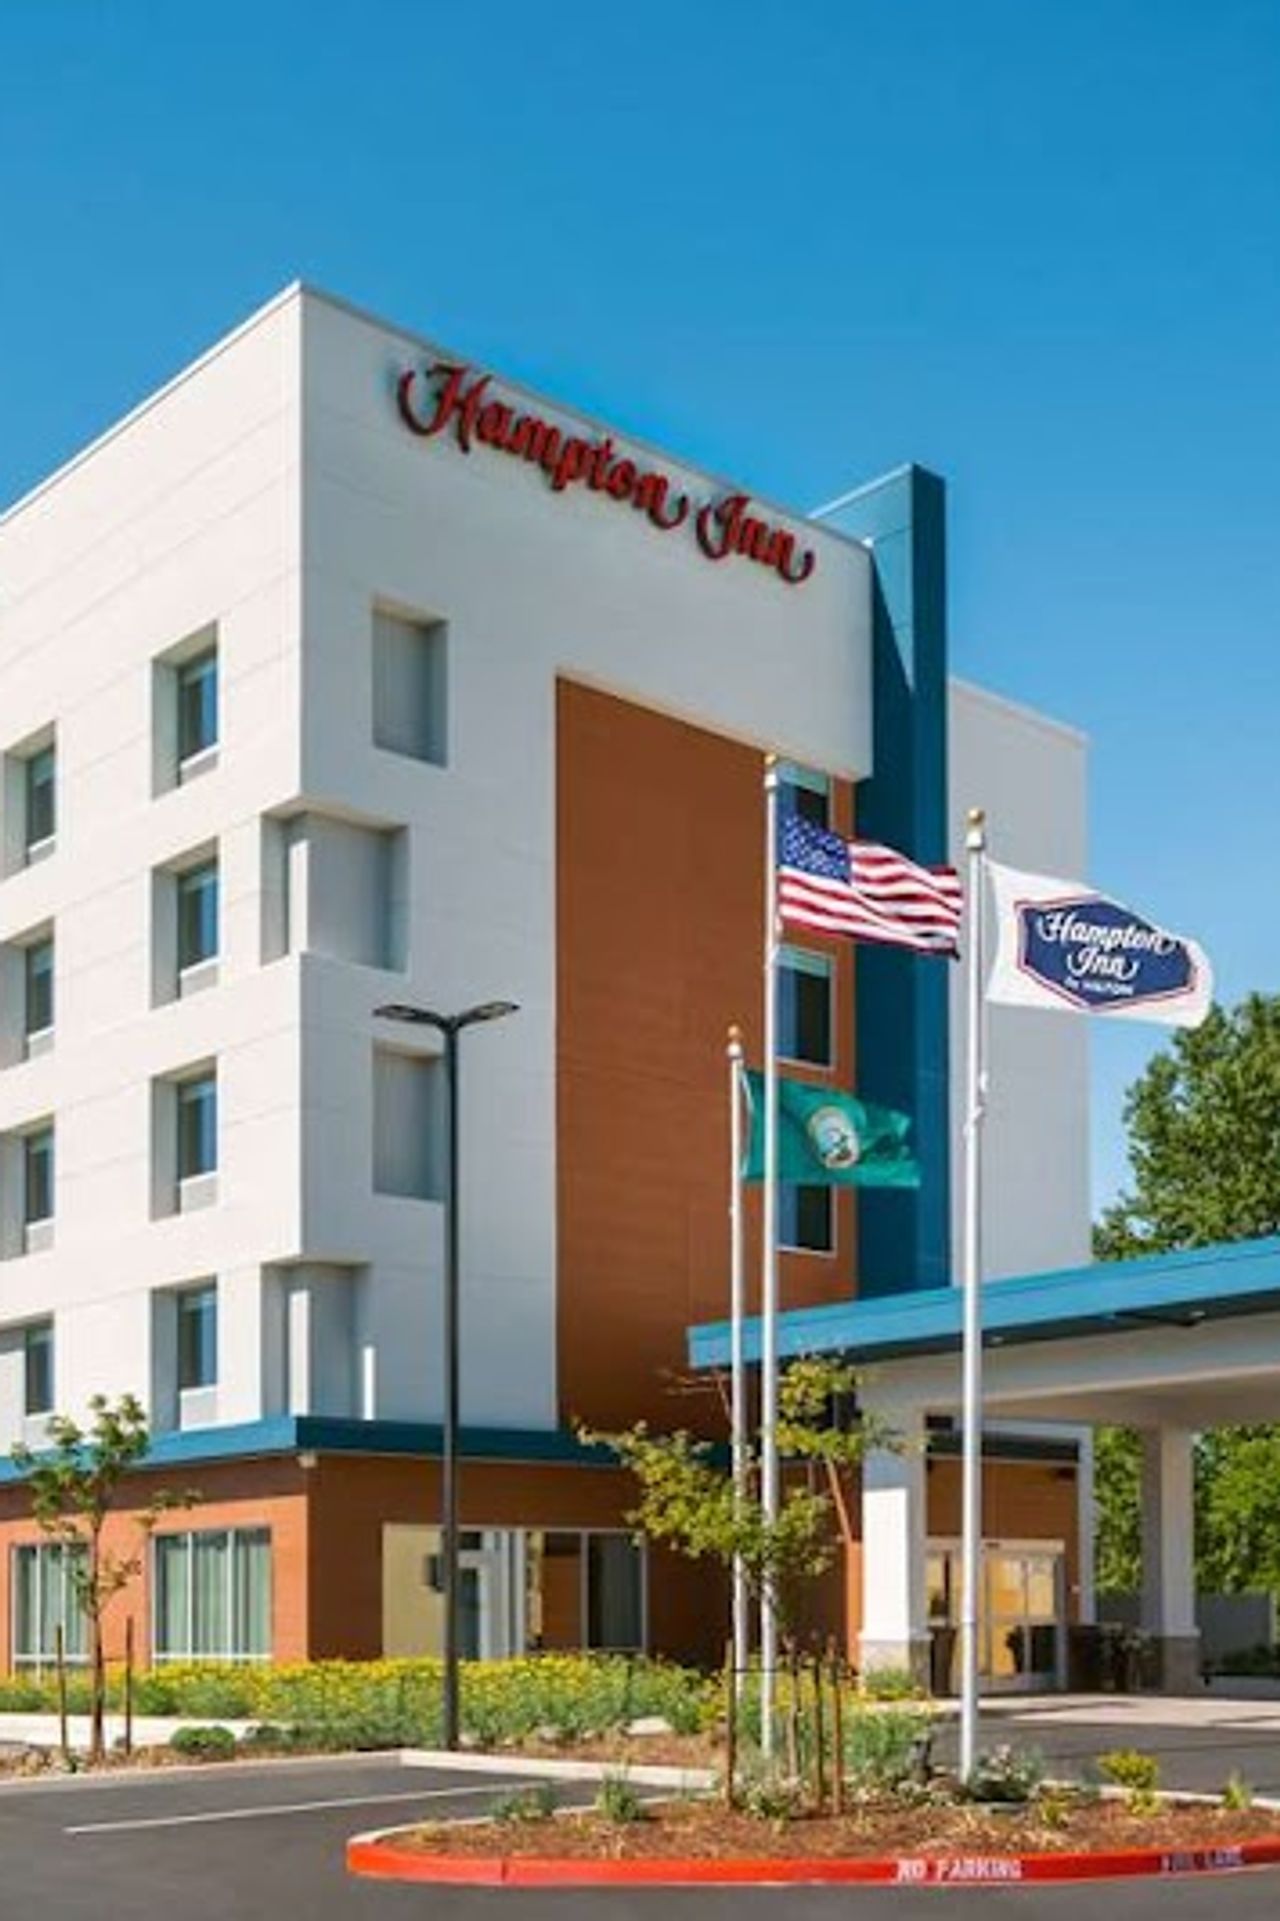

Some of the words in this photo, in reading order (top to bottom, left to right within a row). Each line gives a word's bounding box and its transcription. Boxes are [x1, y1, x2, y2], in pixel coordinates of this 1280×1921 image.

[397, 362, 688, 529] Hampton
[696, 493, 814, 583] Inn
[1036, 911, 1178, 955] Hampton
[1067, 946, 1139, 980] Inn
[897, 1859, 925, 1882] NO
[936, 1857, 1021, 1881] PARKING
